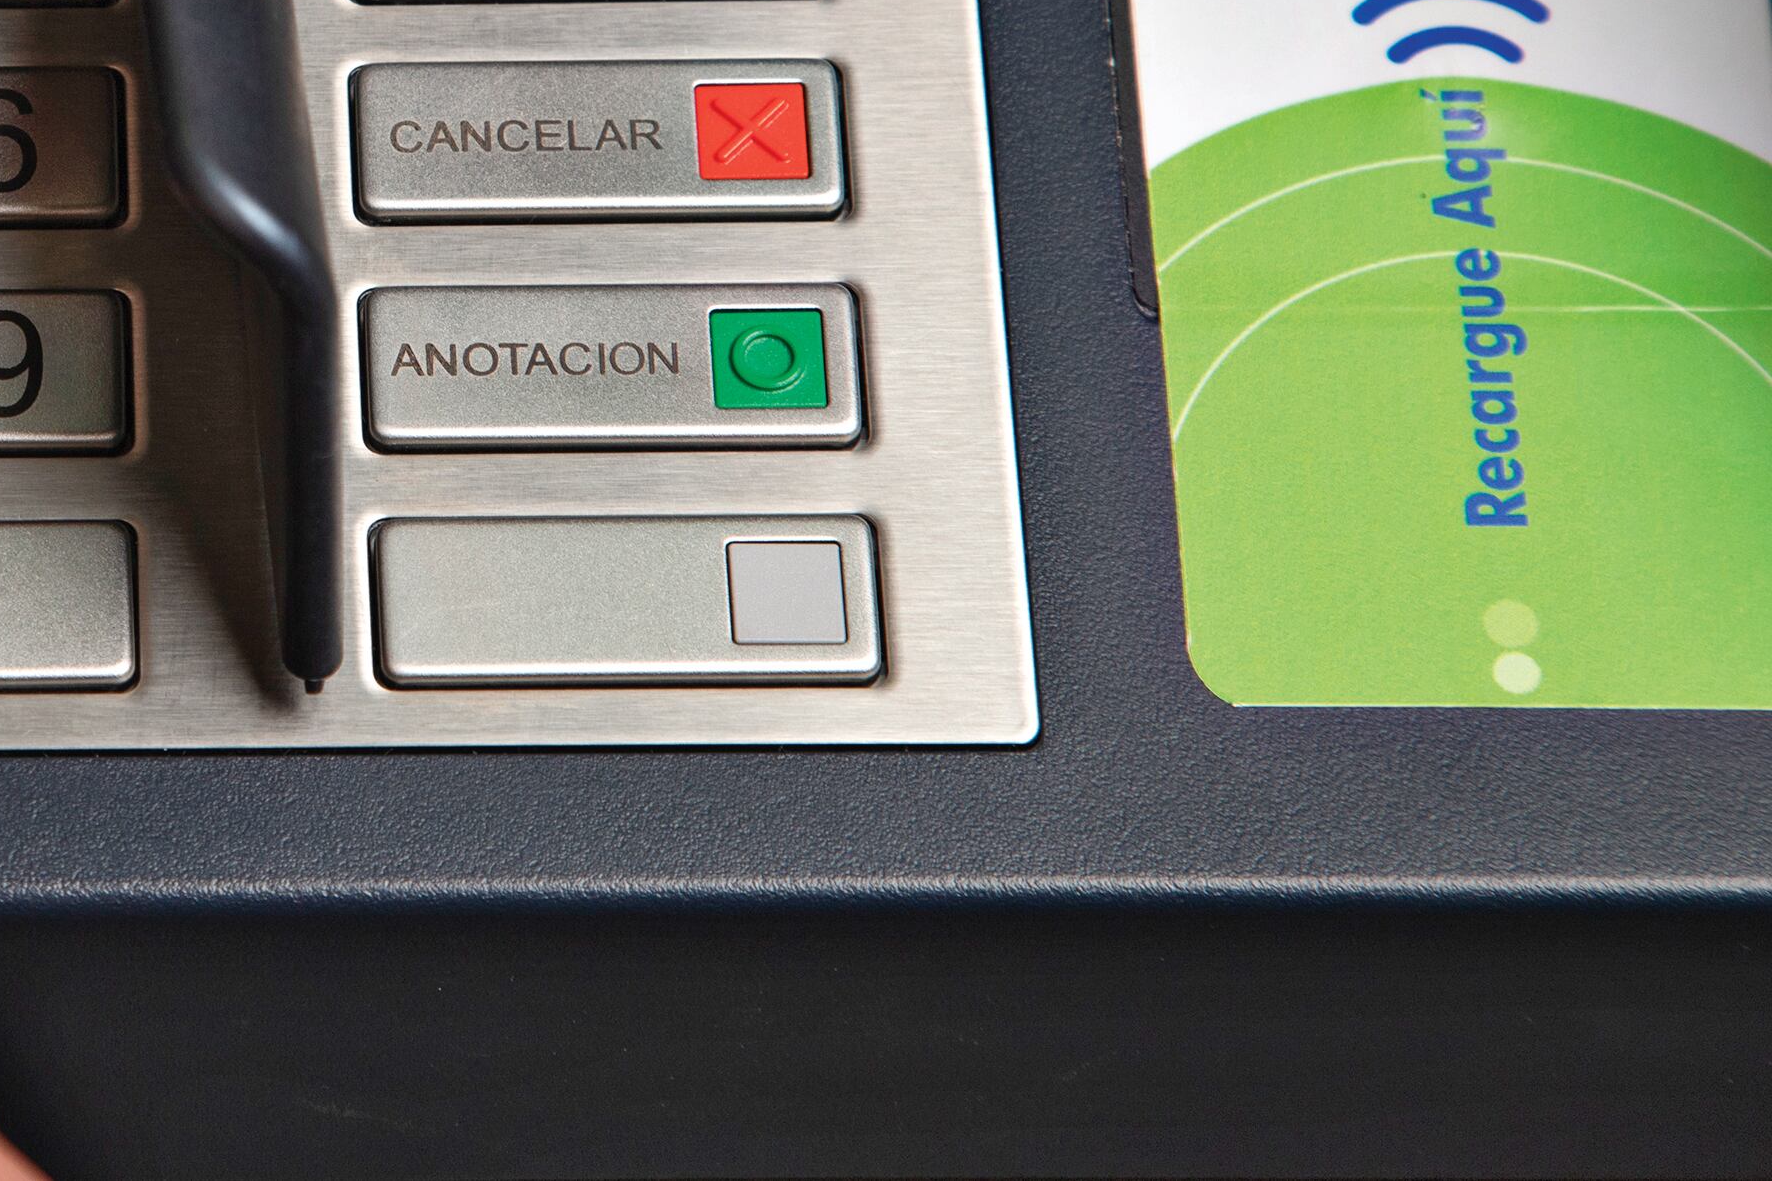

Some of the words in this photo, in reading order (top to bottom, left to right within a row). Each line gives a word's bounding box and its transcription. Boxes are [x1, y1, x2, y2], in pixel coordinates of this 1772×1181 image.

[390, 118, 664, 154] CANCELAR
[1419, 89, 1508, 230] Aquí
[390, 341, 681, 378] ANOTACION
[1455, 247, 1529, 527] Recargue
